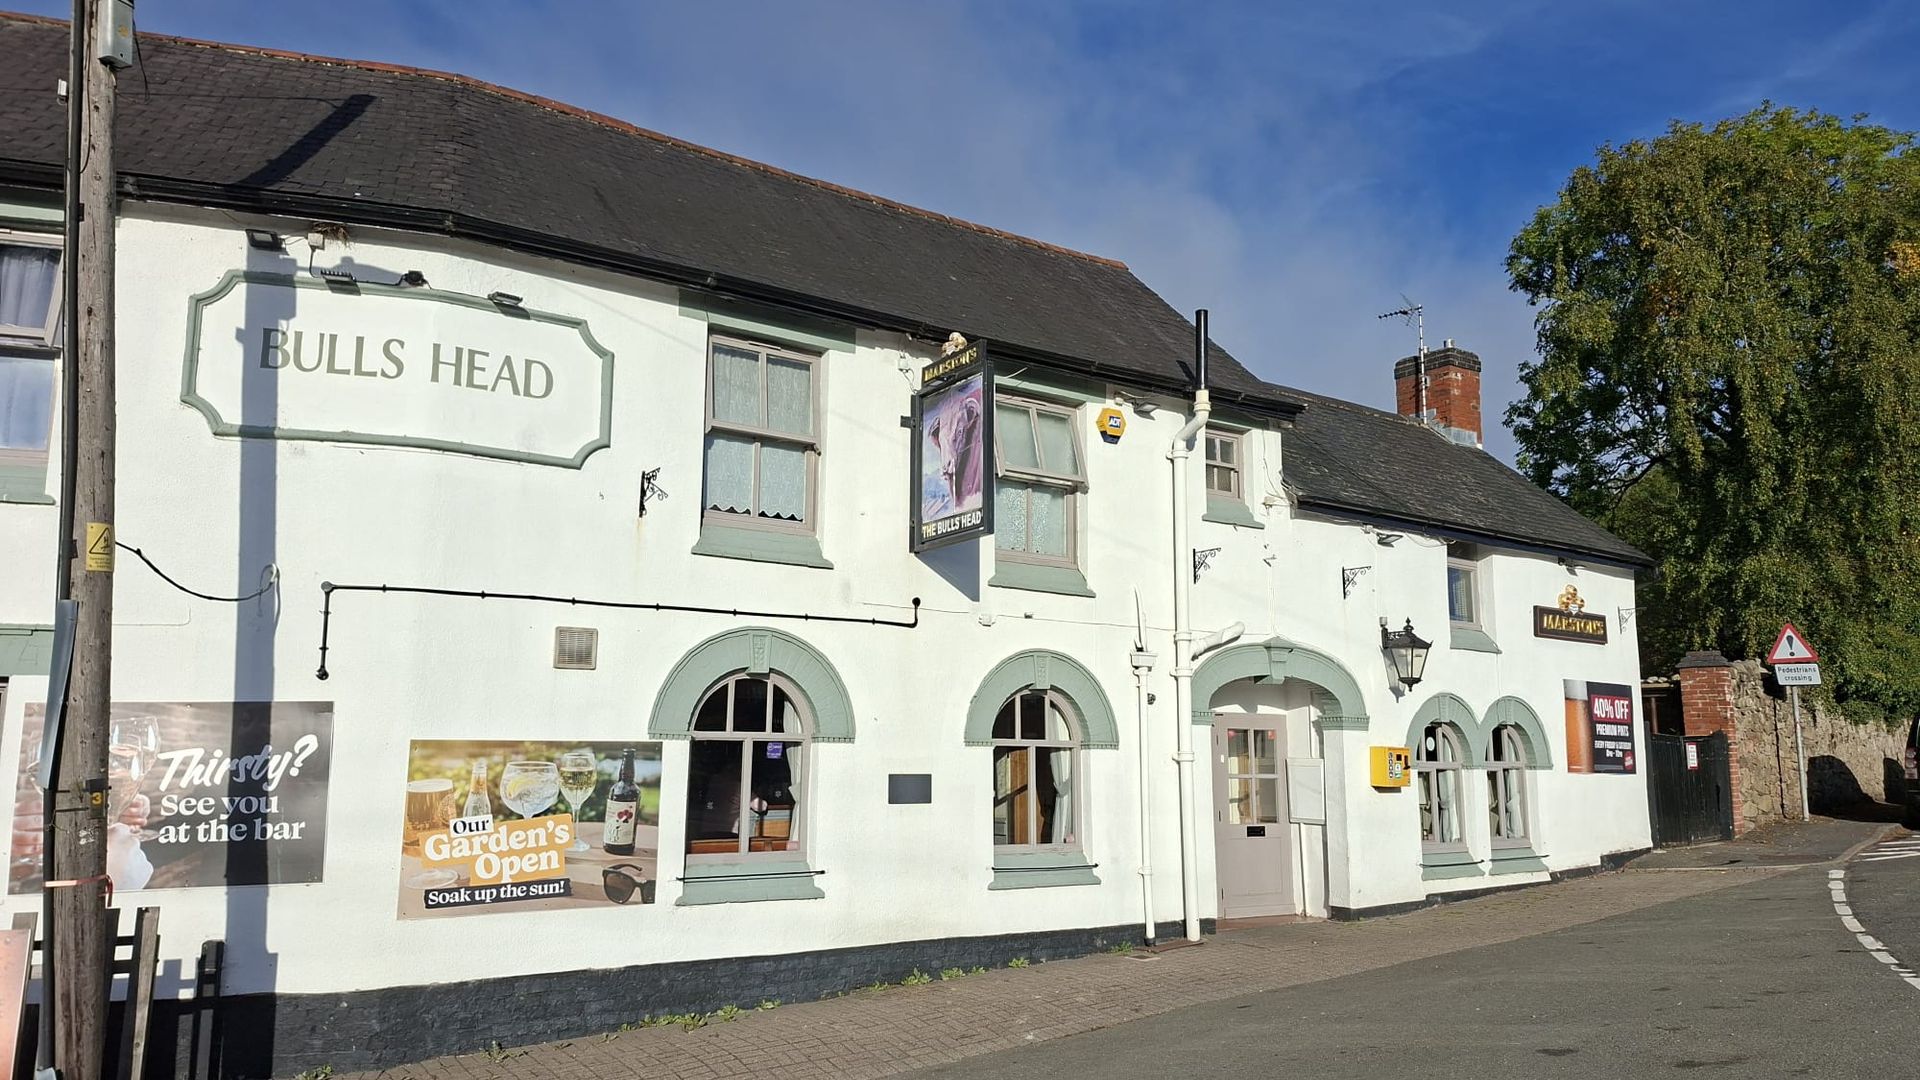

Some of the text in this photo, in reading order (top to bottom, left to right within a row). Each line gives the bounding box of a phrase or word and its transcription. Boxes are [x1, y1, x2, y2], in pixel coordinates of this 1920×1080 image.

[260, 328, 554, 399] BULLS HEAD
[922, 511, 981, 539] THE BULLS HEAD
[1594, 698, 1629, 719] 40% OFF
[157, 734, 319, 792] Thirsty?
[92, 792, 102, 805] 3
[161, 794, 279, 820] See you
[158, 818, 305, 843] at the bar
[453, 819, 489, 834] Our
[474, 850, 560, 883] Open
[428, 880, 565, 905] Soak up the sun!
